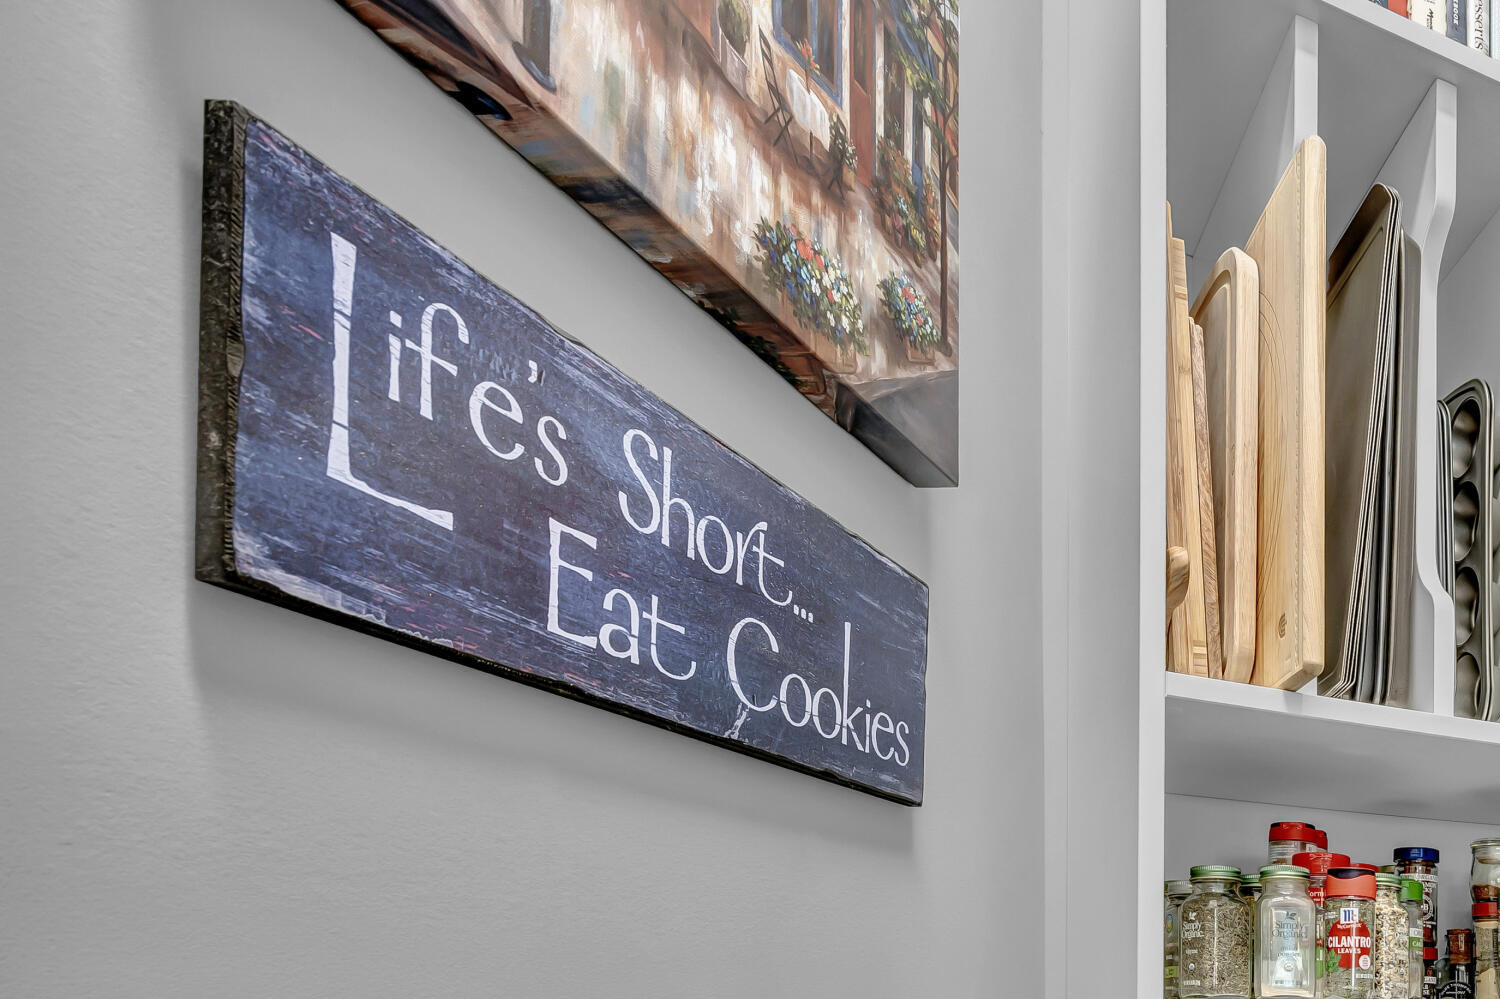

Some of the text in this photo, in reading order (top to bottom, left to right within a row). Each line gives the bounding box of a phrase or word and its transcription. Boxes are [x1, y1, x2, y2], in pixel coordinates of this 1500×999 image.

[326, 231, 570, 531] Life's
[546, 516, 911, 768] Eat Cookies
[1182, 921, 1201, 931] Simply
[1275, 920, 1305, 933] Simply
[1328, 936, 1371, 949] CILANTRO
